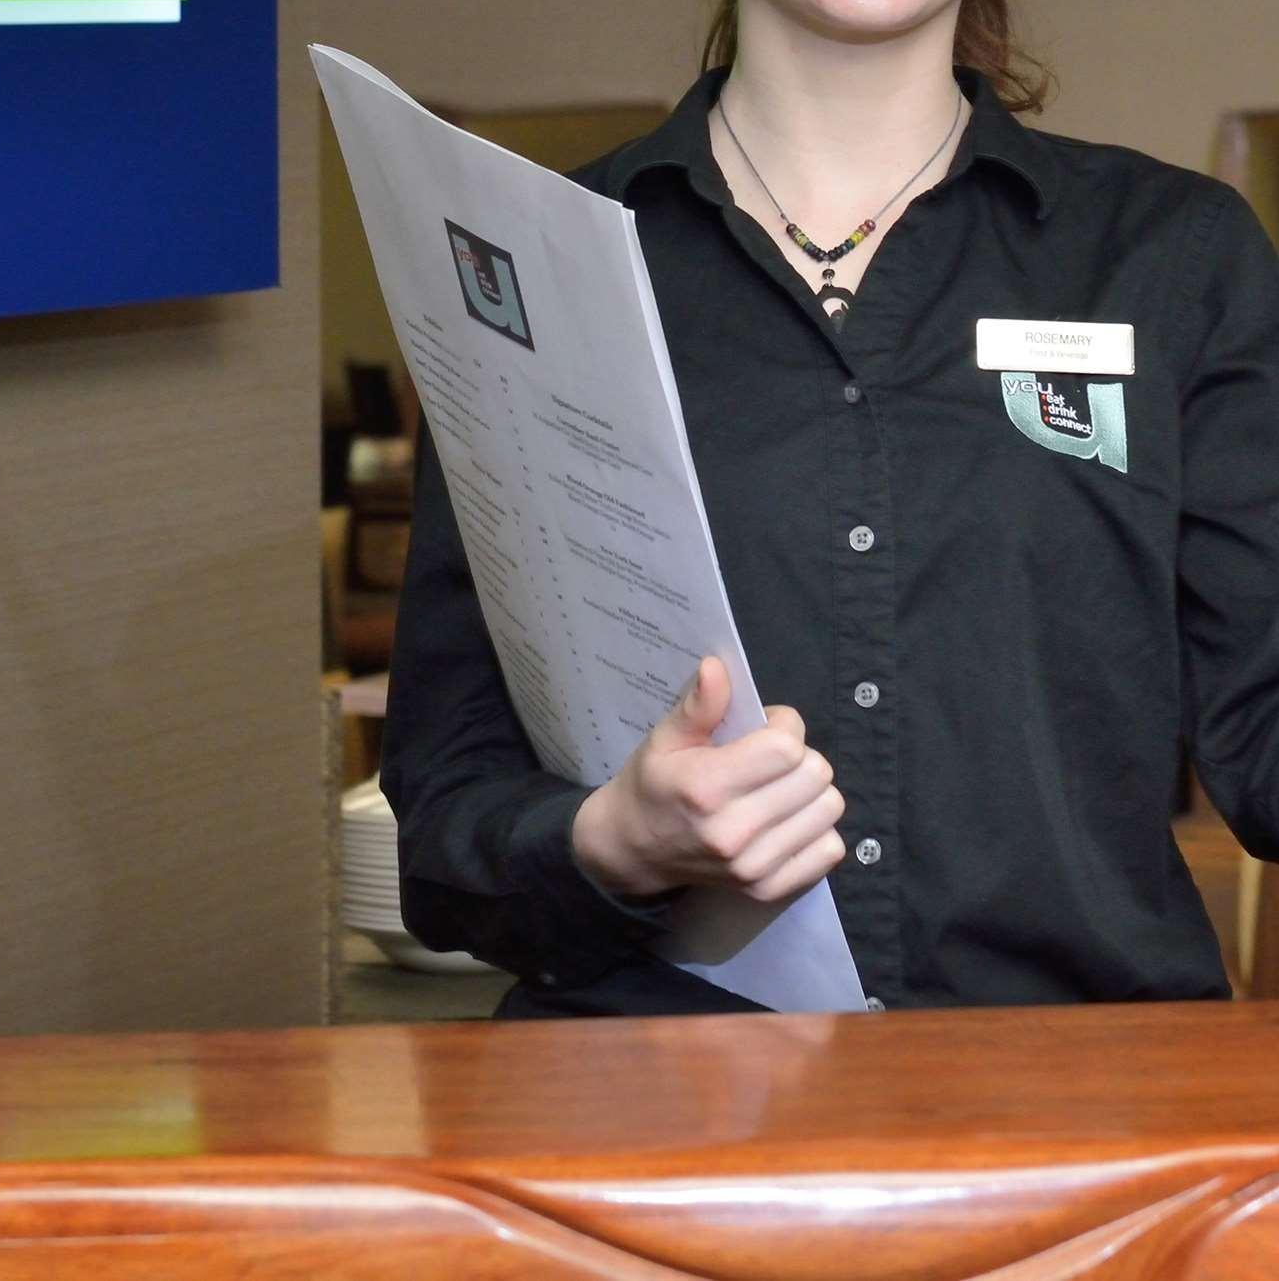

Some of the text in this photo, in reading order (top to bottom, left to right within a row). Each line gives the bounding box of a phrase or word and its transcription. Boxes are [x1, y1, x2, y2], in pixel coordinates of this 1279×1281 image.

[1024, 331, 1093, 347] ROSEMARY
[1003, 379, 1054, 396] you
[1046, 393, 1066, 407] eat
[1048, 403, 1079, 421] drink
[1049, 415, 1093, 435] connect
